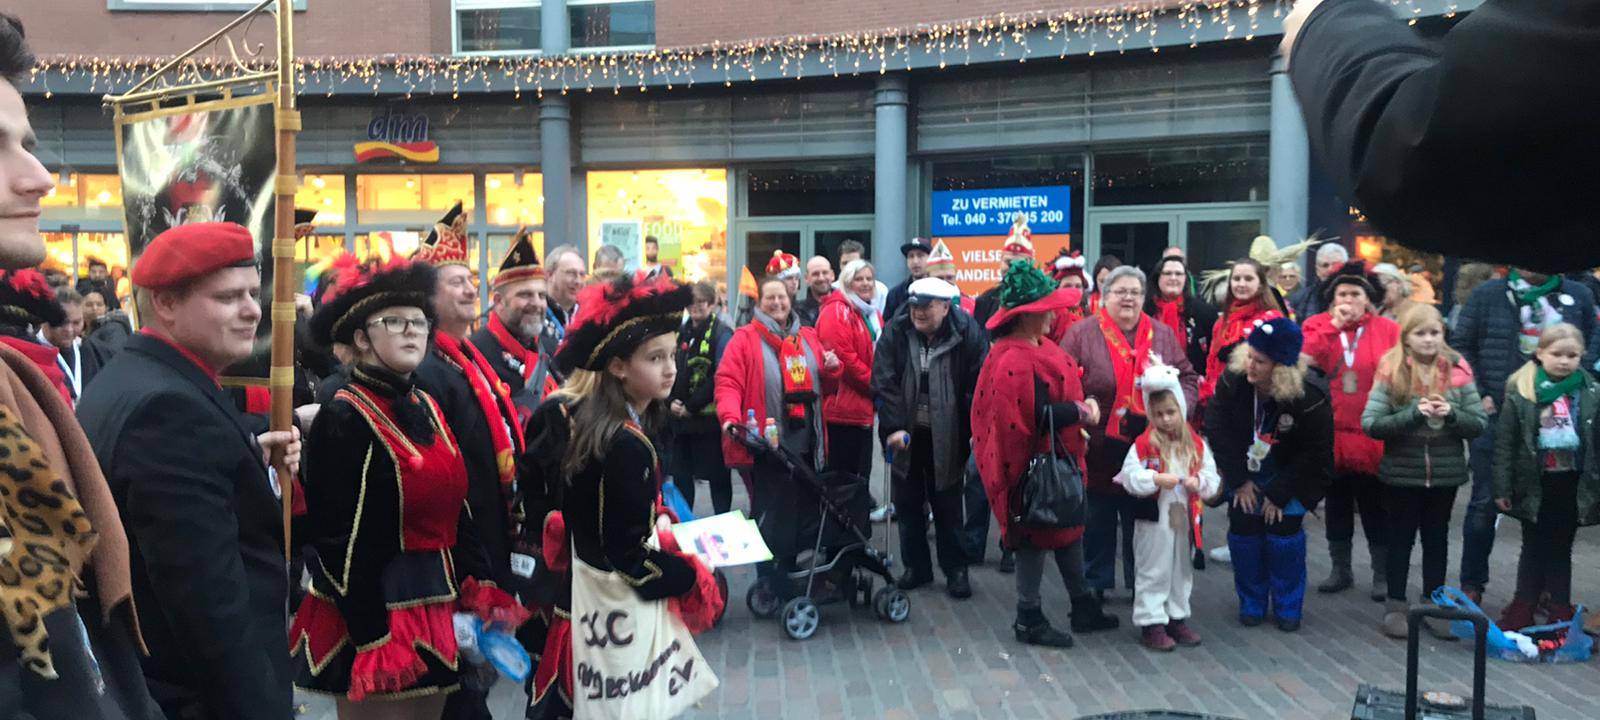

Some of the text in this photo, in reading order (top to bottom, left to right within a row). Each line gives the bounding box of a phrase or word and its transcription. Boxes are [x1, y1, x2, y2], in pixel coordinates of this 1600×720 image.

[368, 107, 429, 144] dm
[951, 195, 1048, 211] ZU VERMIETEN
[941, 213, 962, 226] Tel.
[965, 213, 986, 226] 040
[1040, 210, 1063, 223] 200
[961, 249, 1003, 263] VIELSE
[955, 268, 1003, 281] ANDELS
